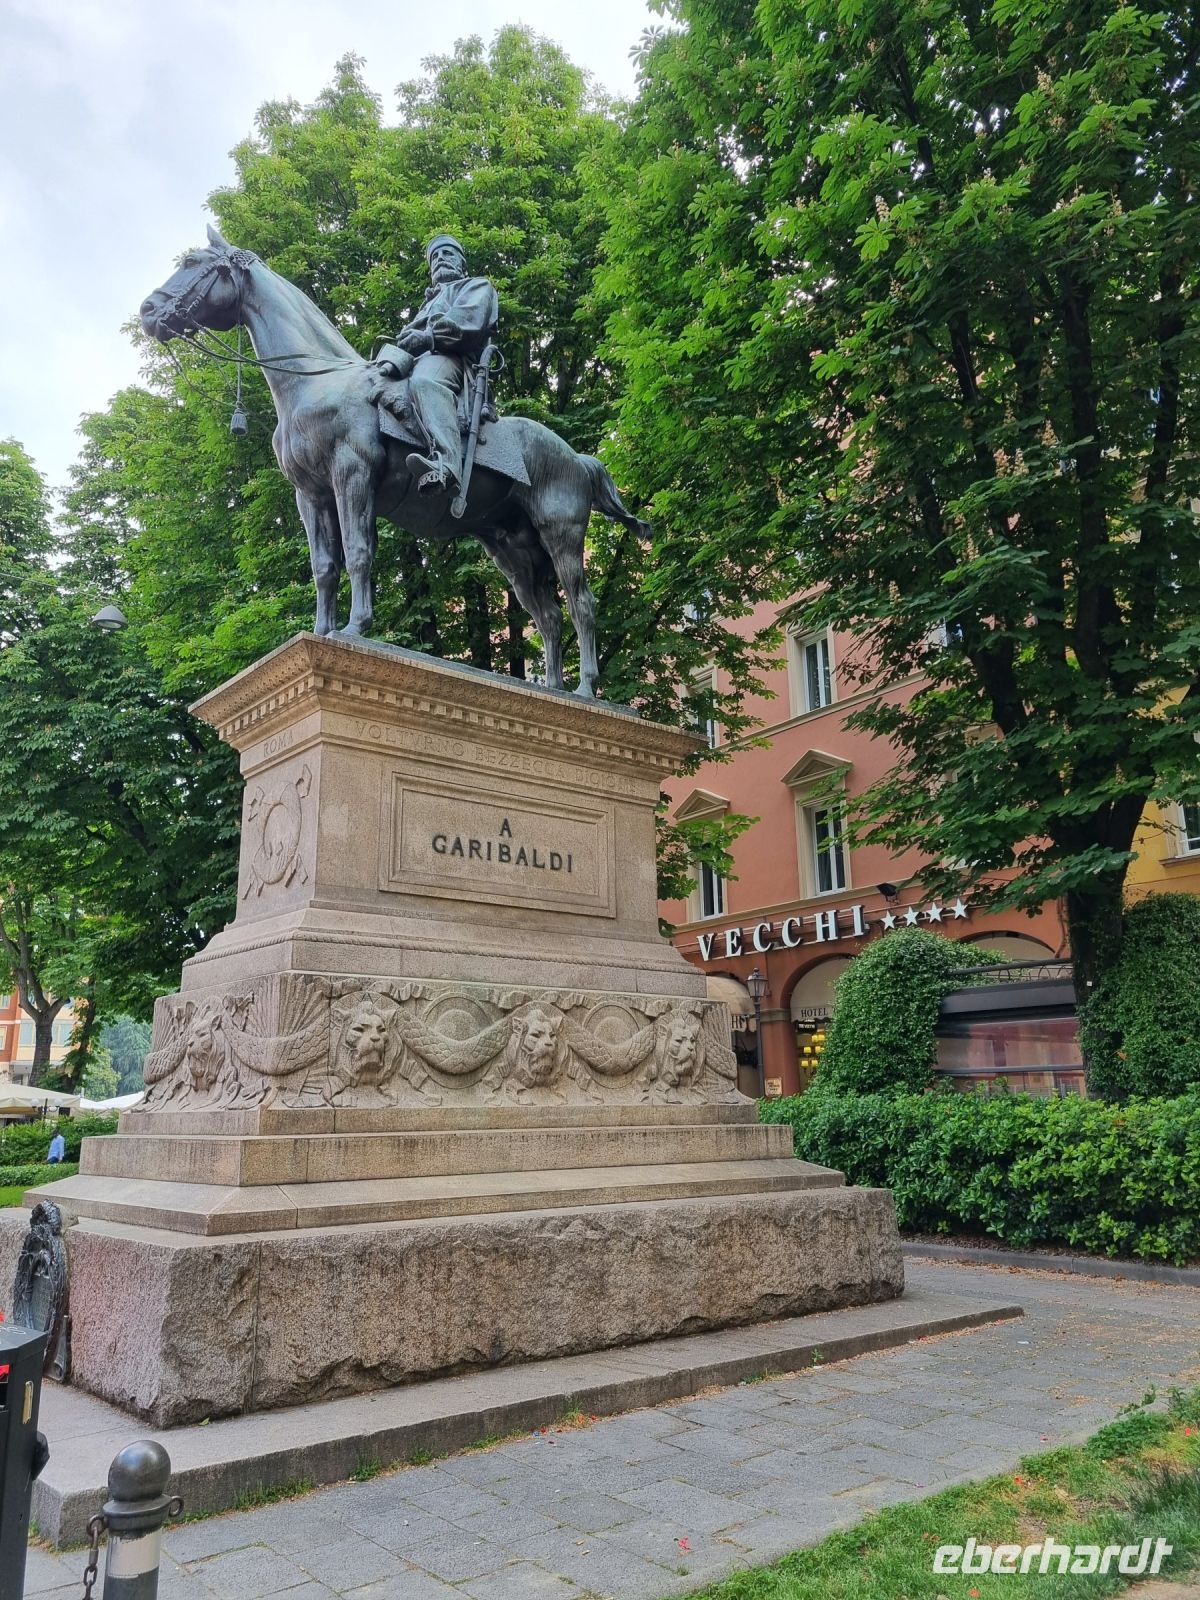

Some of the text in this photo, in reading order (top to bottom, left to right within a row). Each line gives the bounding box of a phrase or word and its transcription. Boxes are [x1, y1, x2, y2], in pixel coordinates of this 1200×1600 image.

[263, 729, 294, 758] ROMA
[499, 818, 512, 838] A
[432, 834, 572, 873] GARIBALDI
[696, 904, 867, 962] VECCHI
[801, 1007, 828, 1018] HOTEL
